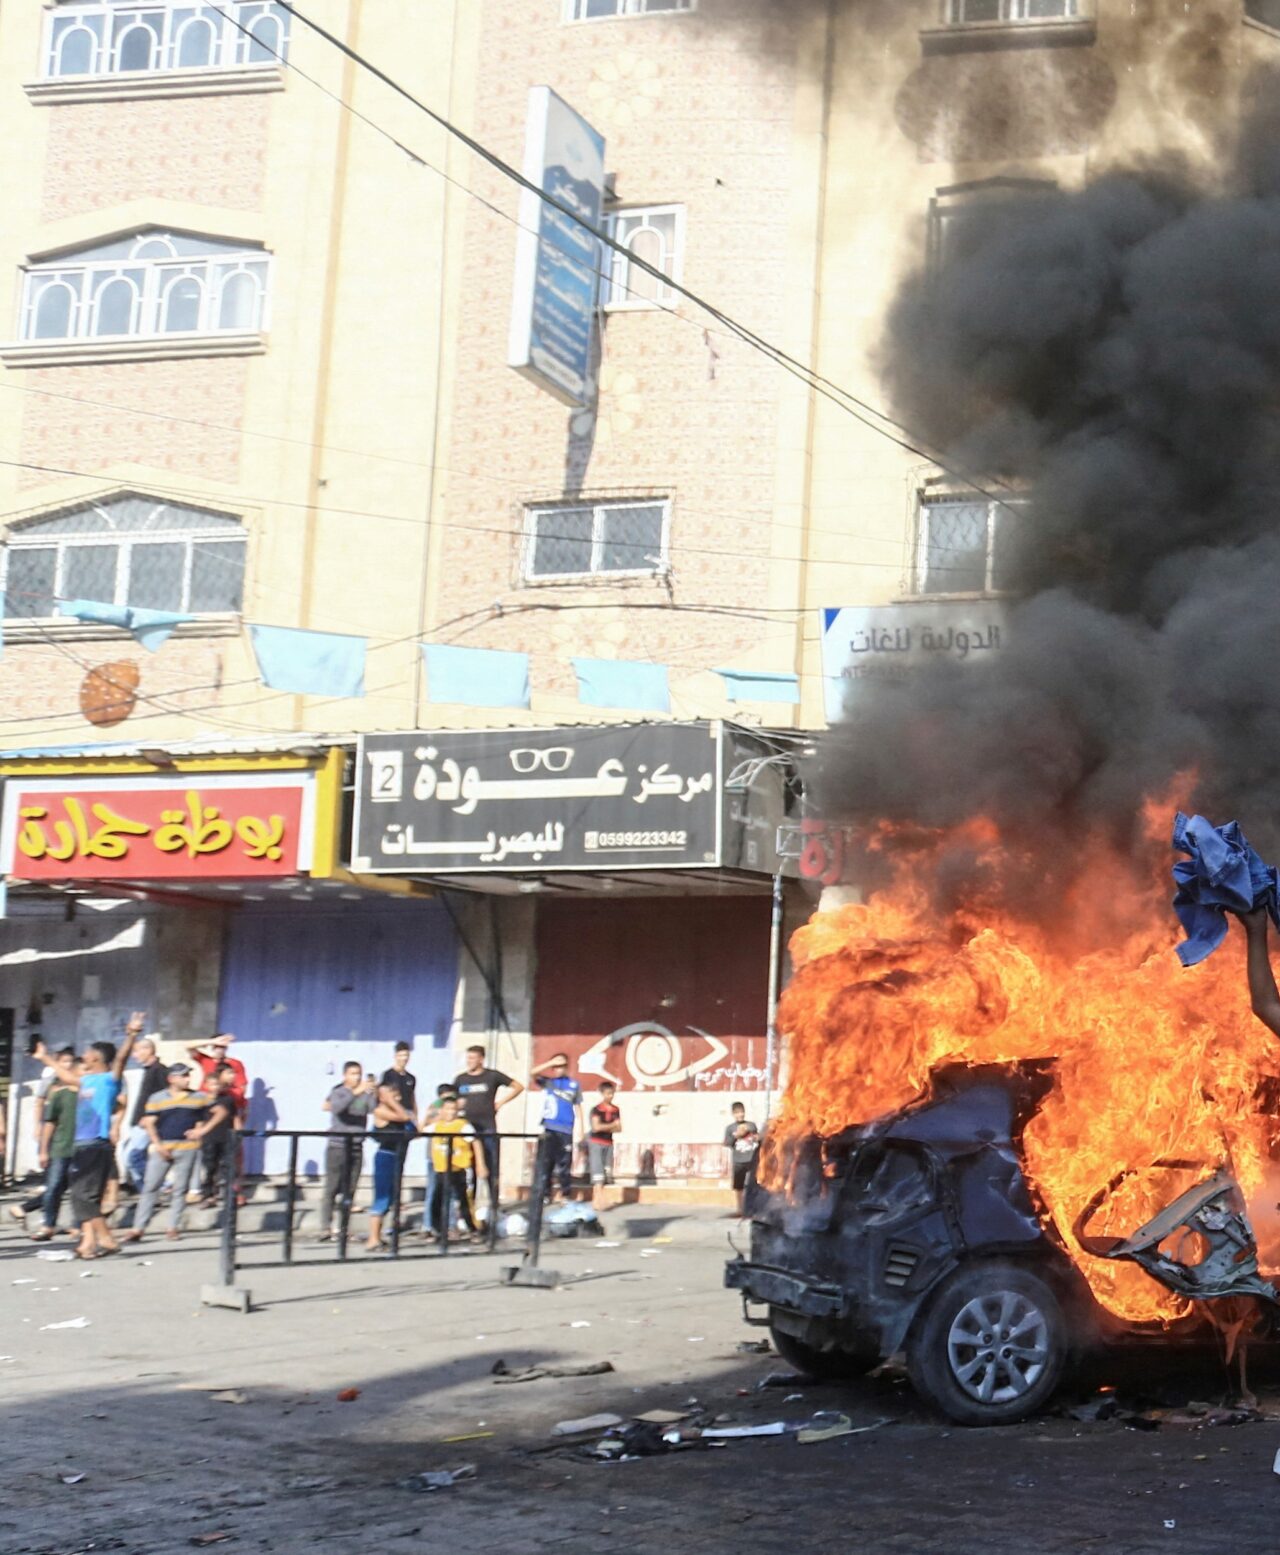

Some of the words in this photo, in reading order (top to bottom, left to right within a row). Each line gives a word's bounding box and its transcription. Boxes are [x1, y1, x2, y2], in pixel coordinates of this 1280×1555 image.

[850, 627, 911, 653] للغات
[921, 624, 1001, 661] الدولية
[413, 746, 629, 815] عودة
[632, 763, 714, 804] مركز
[18, 796, 151, 860] حمادة
[153, 789, 286, 861] بوظة
[381, 821, 565, 862] للبصريات
[599, 830, 688, 847] 0599223342
